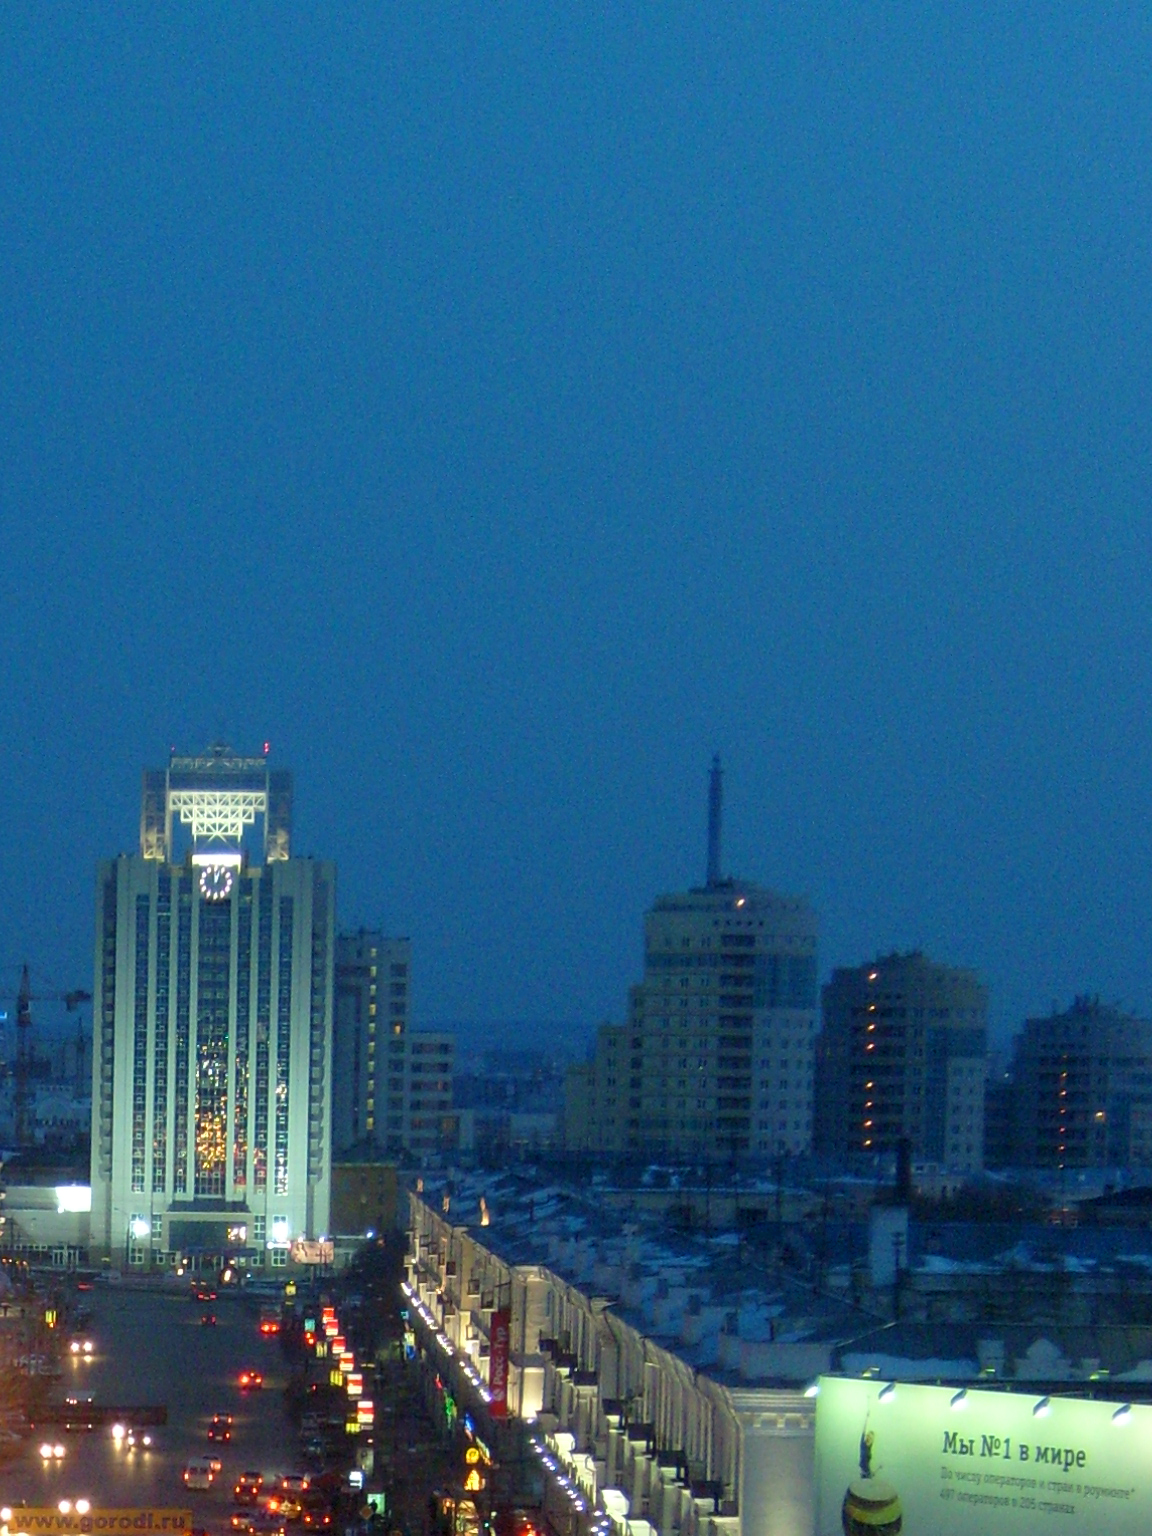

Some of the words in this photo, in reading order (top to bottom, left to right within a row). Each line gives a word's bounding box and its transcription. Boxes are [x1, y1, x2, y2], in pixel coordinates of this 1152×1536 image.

[942, 1430, 975, 1456] Мы
[980, 1434, 1012, 1459] №1
[1019, 1444, 1030, 1461] в
[1035, 1445, 1087, 1472] мире
[954, 1471, 981, 1486] числу
[984, 1474, 1036, 1491] операторов
[1048, 1481, 1074, 1494] стран
[957, 1491, 1009, 1509] операторов
[1039, 1500, 1076, 1515] странах
